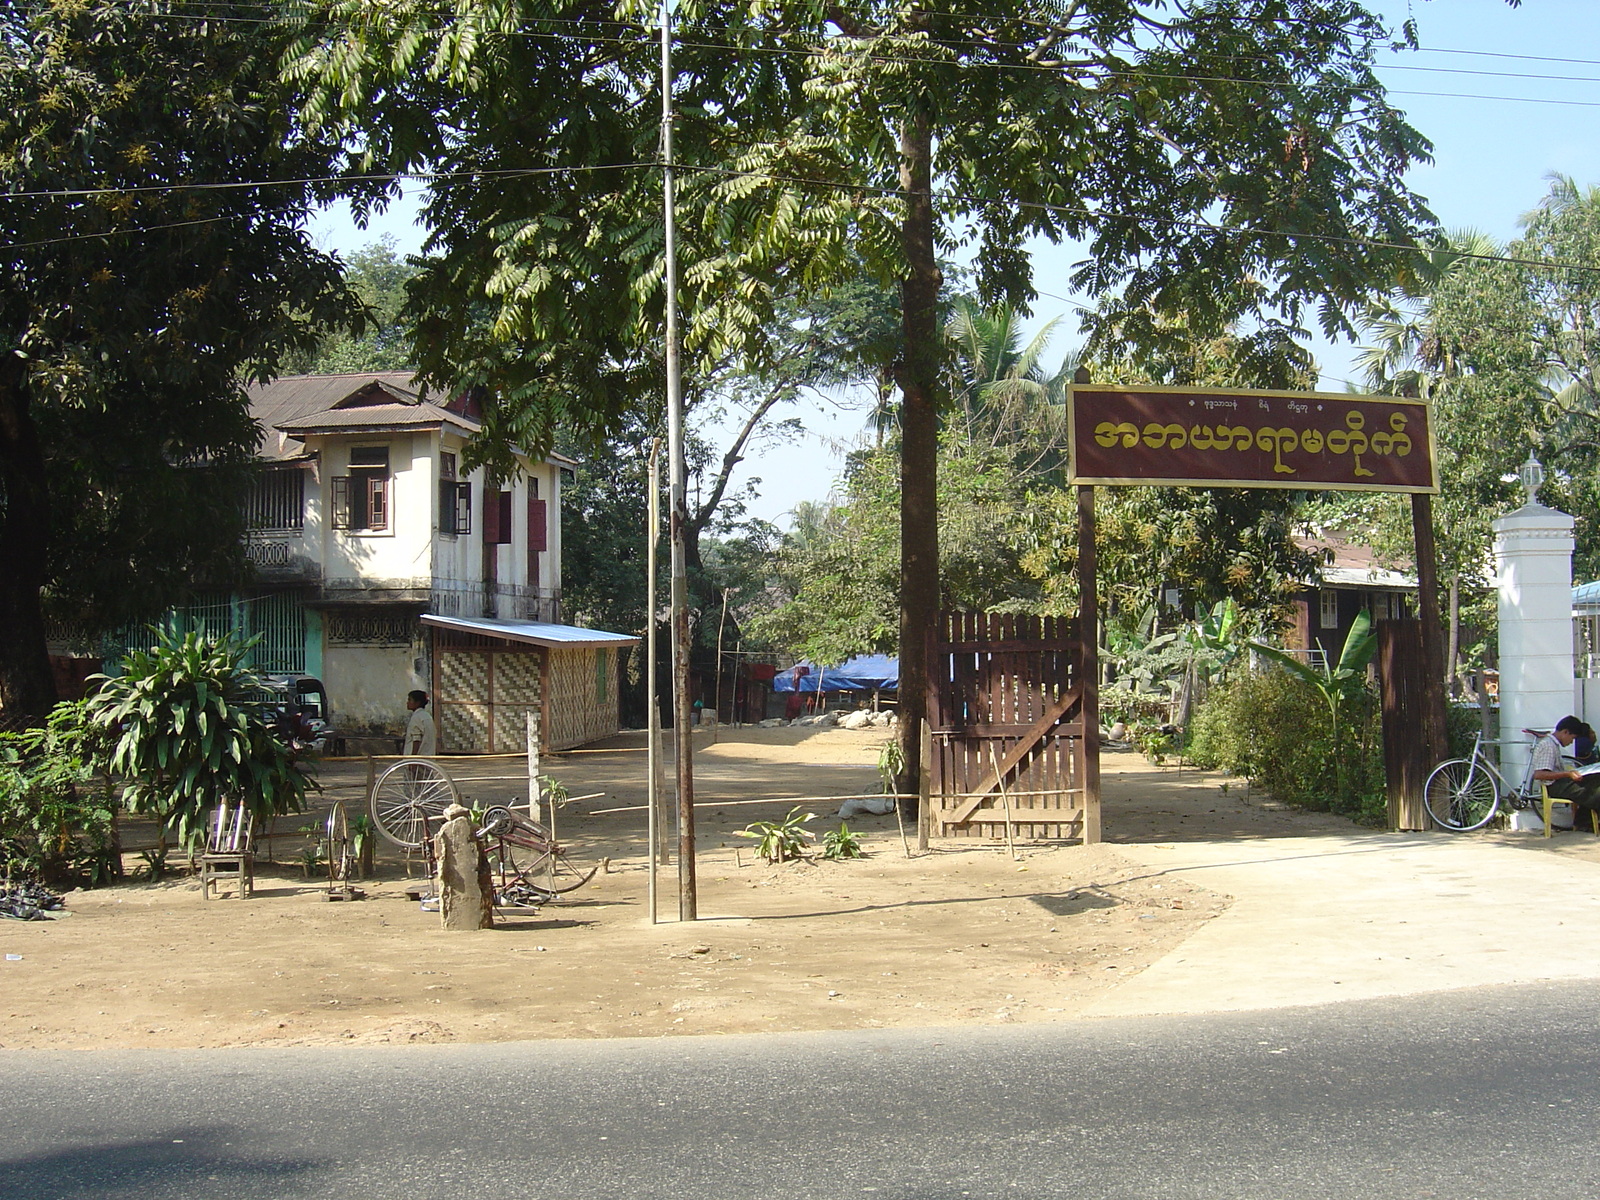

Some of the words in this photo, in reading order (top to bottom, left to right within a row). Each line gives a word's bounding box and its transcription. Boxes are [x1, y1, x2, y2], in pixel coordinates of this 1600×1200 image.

[1094, 410, 1412, 477] အဘယာရာမတိုက်
